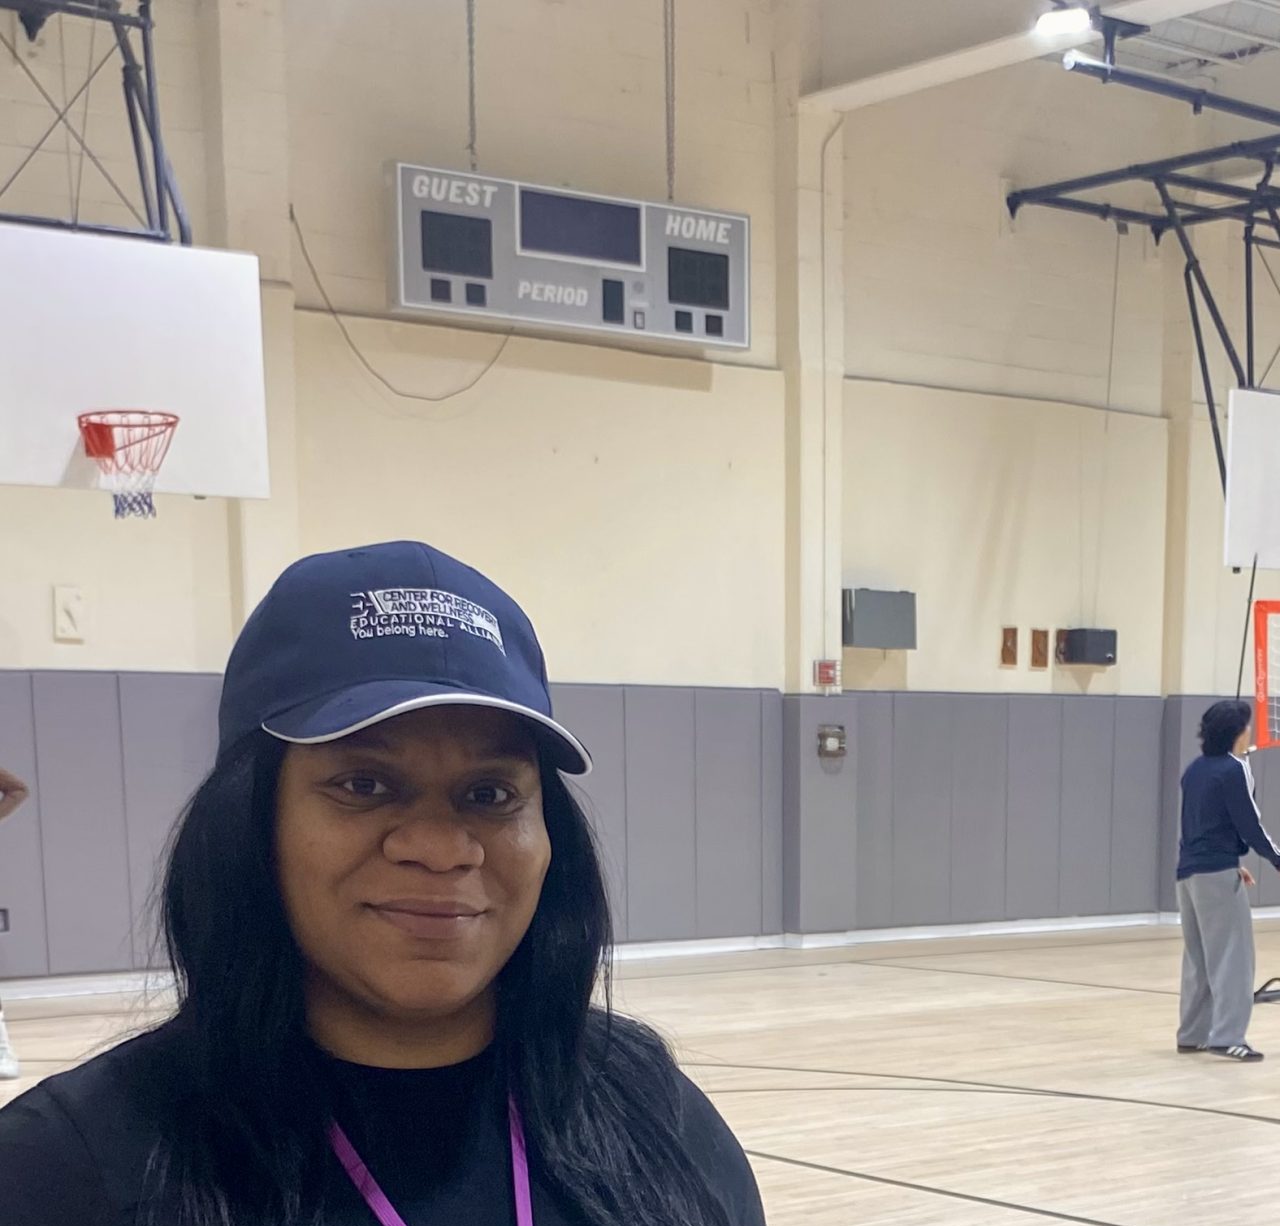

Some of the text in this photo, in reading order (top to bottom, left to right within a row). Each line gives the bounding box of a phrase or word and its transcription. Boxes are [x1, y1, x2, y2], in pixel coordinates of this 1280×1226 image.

[412, 174, 498, 208] GUEST
[665, 213, 732, 245] HOME
[517, 280, 589, 307] PERIOD
[383, 590, 428, 602] CENTER
[430, 590, 453, 605] FOR
[391, 602, 474, 624] AND WELLNESS
[350, 613, 505, 653] EDUCATIONAL ALLIA
[351, 623, 449, 640] You belong here.
